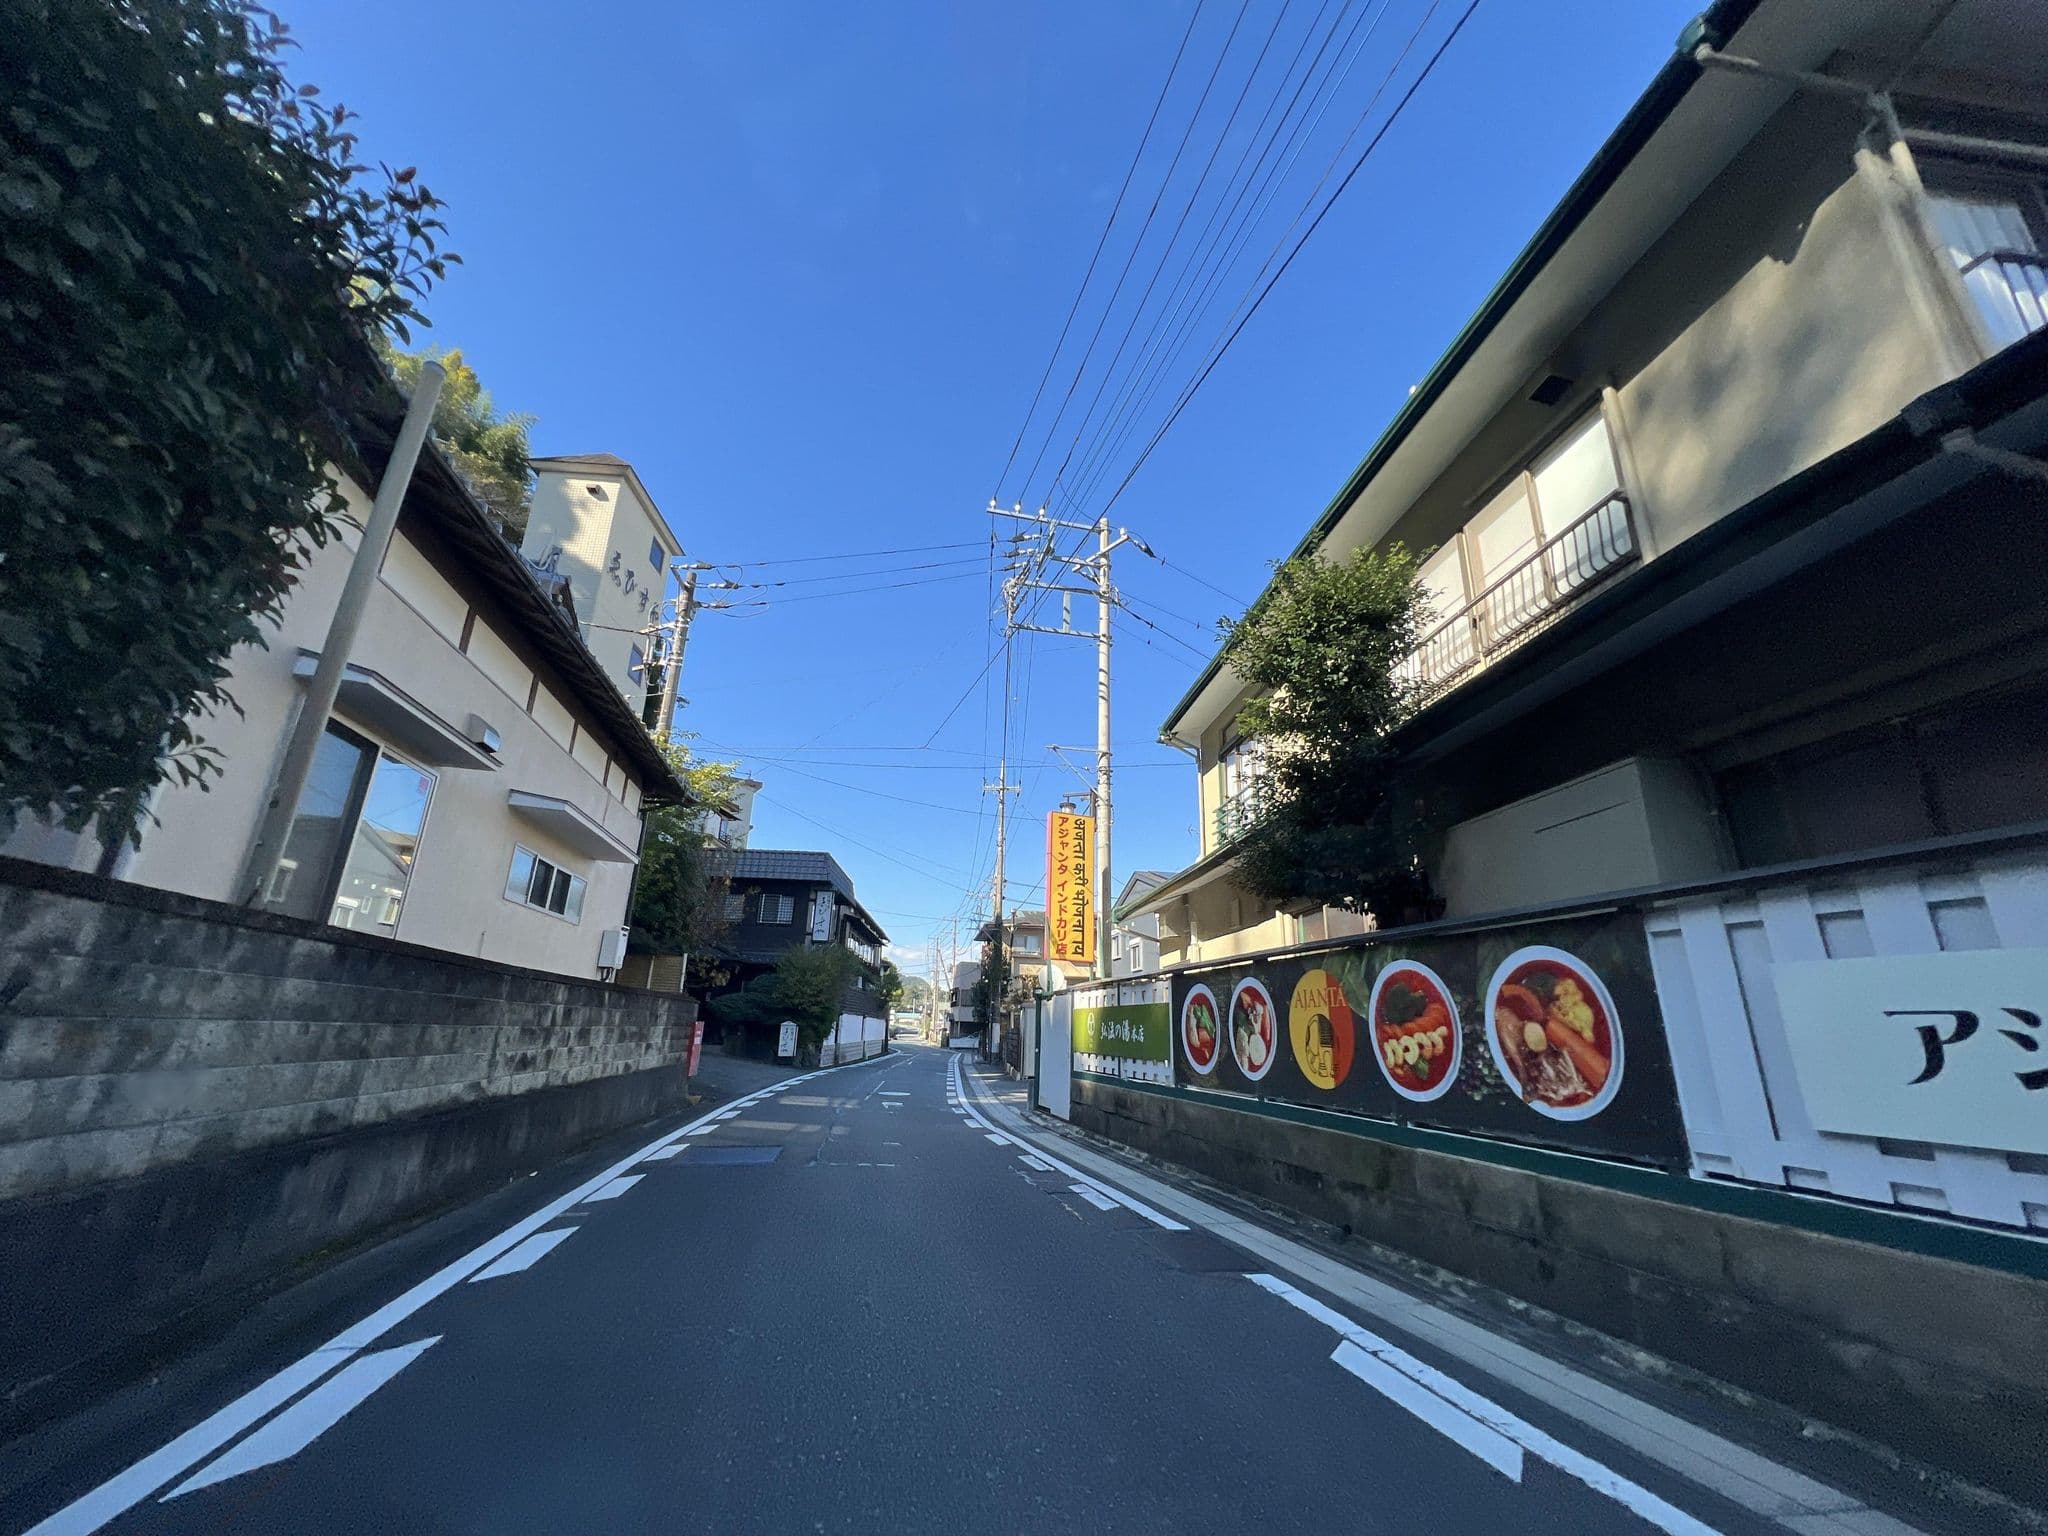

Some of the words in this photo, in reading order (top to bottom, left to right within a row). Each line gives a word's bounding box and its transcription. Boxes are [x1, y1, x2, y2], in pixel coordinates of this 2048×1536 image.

[1057, 817, 1070, 875] アジャンタ
[1056, 880, 1069, 954] インドカリ店
[1295, 986, 1347, 1011] AJANTA
